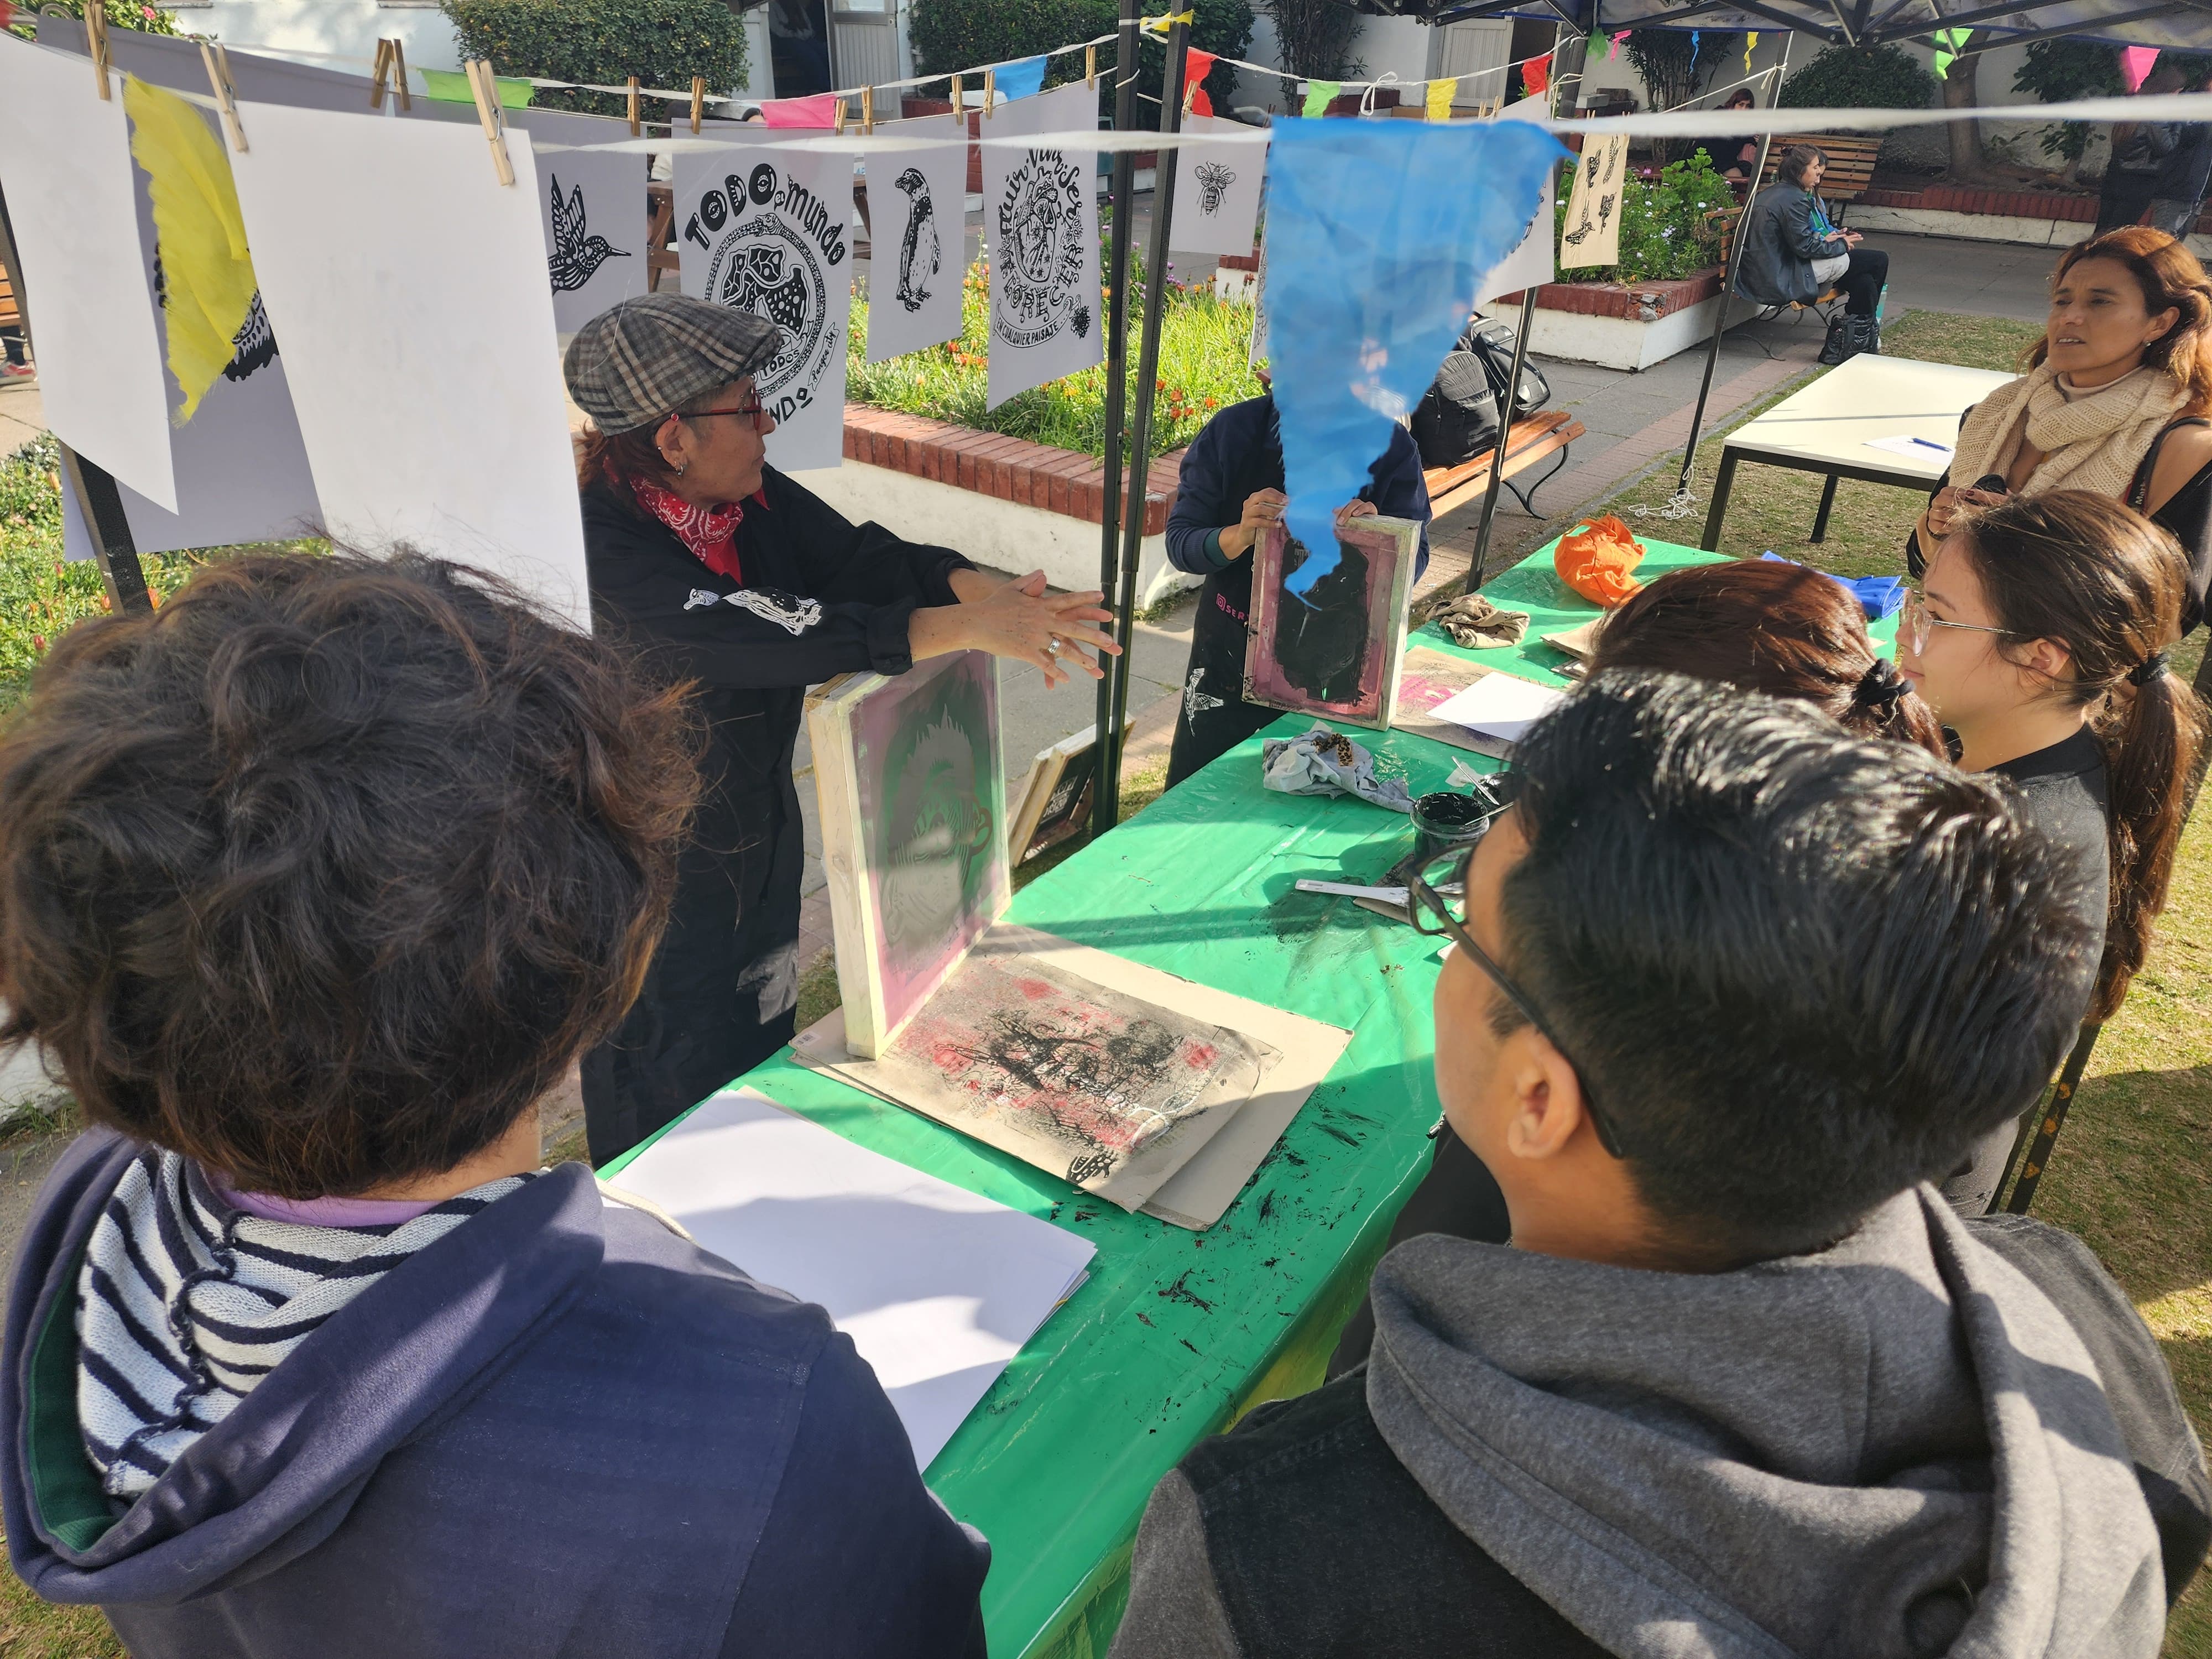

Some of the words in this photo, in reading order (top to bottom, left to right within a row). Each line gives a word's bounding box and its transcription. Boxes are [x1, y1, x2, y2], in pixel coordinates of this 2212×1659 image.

[685, 163, 776, 251] TODO
[996, 317, 1004, 332] EN
[1002, 325, 1030, 345] CUALQUIER
[1031, 321, 1058, 344] PAISAJE
[760, 349, 800, 377] TODOS
[765, 388, 813, 425] NDO
[1225, 605, 1250, 620] SER
